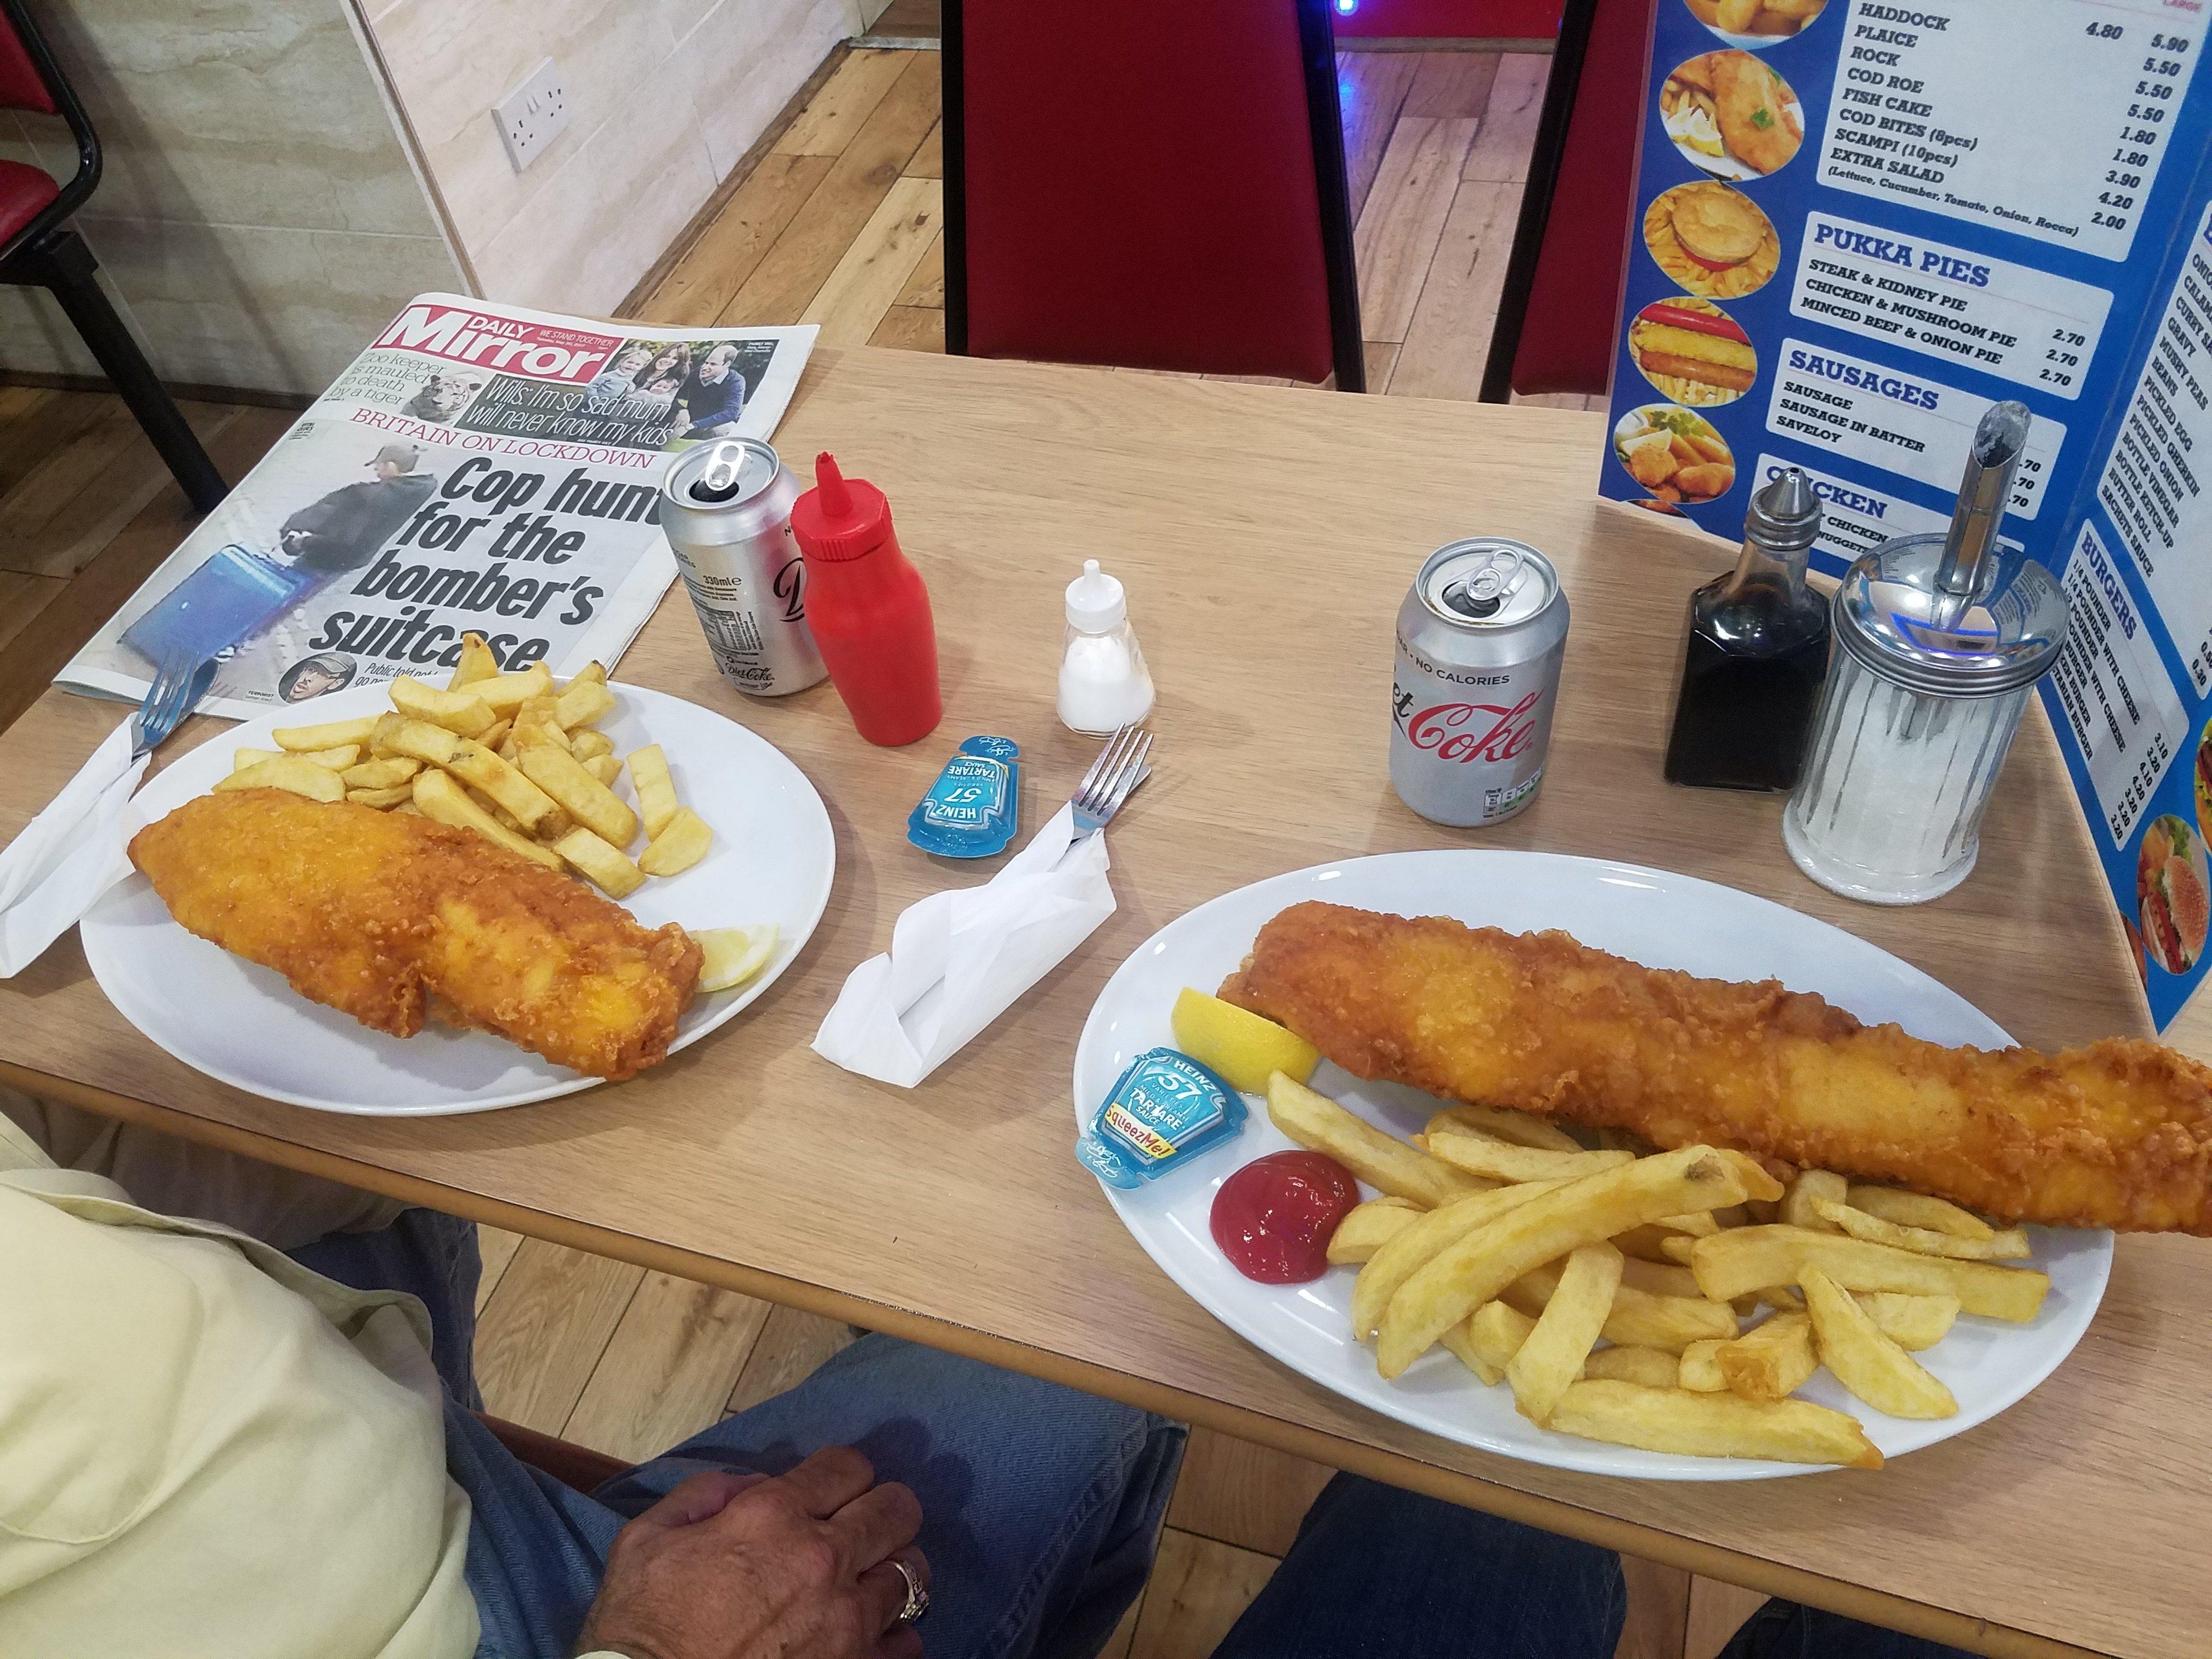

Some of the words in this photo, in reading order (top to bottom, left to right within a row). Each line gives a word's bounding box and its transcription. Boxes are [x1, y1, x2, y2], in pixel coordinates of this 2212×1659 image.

[1858, 3, 1950, 31] HADDOCK
[1854, 25, 1918, 48] PLAICE
[2085, 22, 2124, 40] 4.80
[2151, 33, 2190, 53] 5.90
[1850, 46, 1901, 66] ROCK
[2142, 57, 2182, 77] 5.50
[1847, 67, 1884, 85] COD
[1886, 75, 1925, 94] ROE
[2135, 80, 2174, 100] 5.50
[1842, 88, 1883, 106] FISH
[1885, 97, 1933, 117] CAKE
[2127, 104, 2165, 123] 5.50
[1839, 108, 1876, 126] COD
[1877, 116, 1927, 138] BITES
[1929, 128, 1978, 151] (8pcs)
[2120, 126, 2157, 145] 1.80
[1835, 128, 1900, 153] SCAMPI
[1902, 143, 1959, 168] (10pcs)
[2112, 148, 2149, 167] 1.80
[1830, 147, 1885, 170] EXTRA
[1887, 161, 1945, 183] SALAD
[2105, 170, 2141, 189] 3.90
[1828, 166, 1876, 185] (Lettuce,
[1879, 178, 1940, 201] Cucumber,
[1944, 192, 1989, 213] Tomato,
[1993, 206, 2032, 224] Onion,
[2035, 216, 2079, 238] Rocca)
[2098, 192, 2134, 210] 4.20
[2091, 212, 2127, 230] 2.00
[1814, 223, 1912, 268] PUKKA
[1920, 251, 1990, 287] PIES
[1809, 259, 1860, 281] STEAK
[1861, 274, 1874, 285] &
[1876, 278, 1939, 302] KIDNEY
[1939, 295, 1968, 312] PIE
[467, 316, 534, 338] DAILY
[1805, 278, 1875, 306] CHICKEN
[1876, 298, 1888, 310] &
[1890, 302, 1989, 339] MUSHROOM
[1988, 330, 2018, 348] PIE
[2176, 296, 2204, 336] CURRY
[377, 307, 606, 379] Mirror
[552, 331, 576, 341] STAND
[577, 335, 614, 347] TOGETHER
[1800, 297, 1861, 322] MINCED
[1863, 315, 1903, 334] BEEF
[1904, 328, 1917, 338] &
[1920, 332, 1974, 356] ONION
[1974, 348, 2003, 365] PIE
[2052, 329, 2086, 347] 2.70
[2168, 317, 2197, 358] GRAVY
[359, 353, 389, 364] Zoo
[390, 354, 447, 374] keeper
[2045, 349, 2079, 367] 2.70
[358, 375, 405, 392] death
[364, 365, 432, 383] mauled
[1789, 350, 1940, 410] SAUSAGES
[2039, 369, 2072, 386] 2.70
[2152, 356, 2178, 397] BEANS
[2159, 336, 2189, 379] MUSHY
[2186, 375, 2208, 411] PEAS
[364, 388, 405, 405] tiger
[486, 377, 533, 406] Wills:
[527, 385, 556, 409] I'm
[556, 393, 583, 411] so
[581, 393, 625, 416] sad
[616, 399, 672, 421] mum
[1784, 381, 1854, 410] SAUSAGE
[466, 402, 501, 427] will
[495, 410, 555, 432] never
[546, 411, 605, 437] know
[597, 421, 636, 446] my
[631, 421, 675, 446] kids
[1780, 399, 1849, 428] SAUSAGE
[1849, 421, 1868, 433] IN
[1868, 426, 1926, 453] BATTER
[2144, 375, 2176, 426] PICKLED
[2174, 421, 2193, 453] EGG
[349, 408, 461, 445] BRITAIN
[461, 435, 501, 453] ON
[500, 439, 656, 469] LOCKDOWN
[1776, 415, 1842, 443] SAVELOY
[2130, 413, 2160, 463] PICKLED
[2159, 460, 2184, 503] ONION
[2136, 394, 2168, 444] PICKLED
[2167, 442, 2200, 498] GHERKIN
[2019, 459, 2041, 472] .70
[2115, 449, 2143, 495] BOTTLE
[2122, 431, 2151, 477] BOTTLE
[2148, 471, 2179, 528] VINEGAR
[441, 456, 545, 516] Cop
[544, 467, 663, 525] hunt
[2013, 477, 2035, 490] .70
[2008, 494, 2029, 507] .70
[2108, 467, 2136, 514] BUTTER
[2133, 509, 2152, 543] ROLL
[396, 501, 492, 552] for
[492, 514, 586, 565] the
[1827, 516, 1889, 543] CHICKEN
[2102, 484, 2133, 539] SACHETS
[2130, 534, 2154, 578] SAUCE
[350, 550, 605, 626] bomber's
[2073, 559, 2084, 578] 1/4
[2082, 574, 2111, 633] POUNDER
[2081, 531, 2137, 640] BURGERS
[2070, 603, 2098, 660] POUNDER
[2068, 573, 2078, 592] 1/4
[2076, 589, 2105, 646] POUNDER
[2103, 642, 2120, 678] WITH
[2117, 675, 2140, 725] CHEESE
[364, 663, 394, 676] Public
[725, 663, 747, 679] Diet
[746, 668, 775, 680] Coke
[1415, 657, 1432, 673] NO
[1436, 669, 1510, 685] CALORIES
[2065, 640, 2087, 690] BURGER
[354, 676, 370, 687] go
[2069, 676, 2091, 727] BURGER
[2091, 670, 2106, 705] WITH
[2104, 703, 2126, 754] CHEESE
[1408, 686, 1544, 763] Coke
[2070, 710, 2093, 761] BURGER
[2154, 732, 2168, 760] 3.10
[948, 765, 996, 778] TARTARE
[2147, 747, 2160, 774] 3.20
[944, 788, 982, 803] 57
[2125, 788, 2137, 814] 3.20
[2132, 776, 2145, 801] 4.20
[936, 804, 977, 819] HEINZ
[2118, 801, 2131, 827] 3.20
[2111, 814, 2123, 840] 3.20
[1158, 1073, 1203, 1100] 57
[1173, 1060, 1217, 1092] HEINZ
[1136, 1104, 1160, 1126] SAUCE
